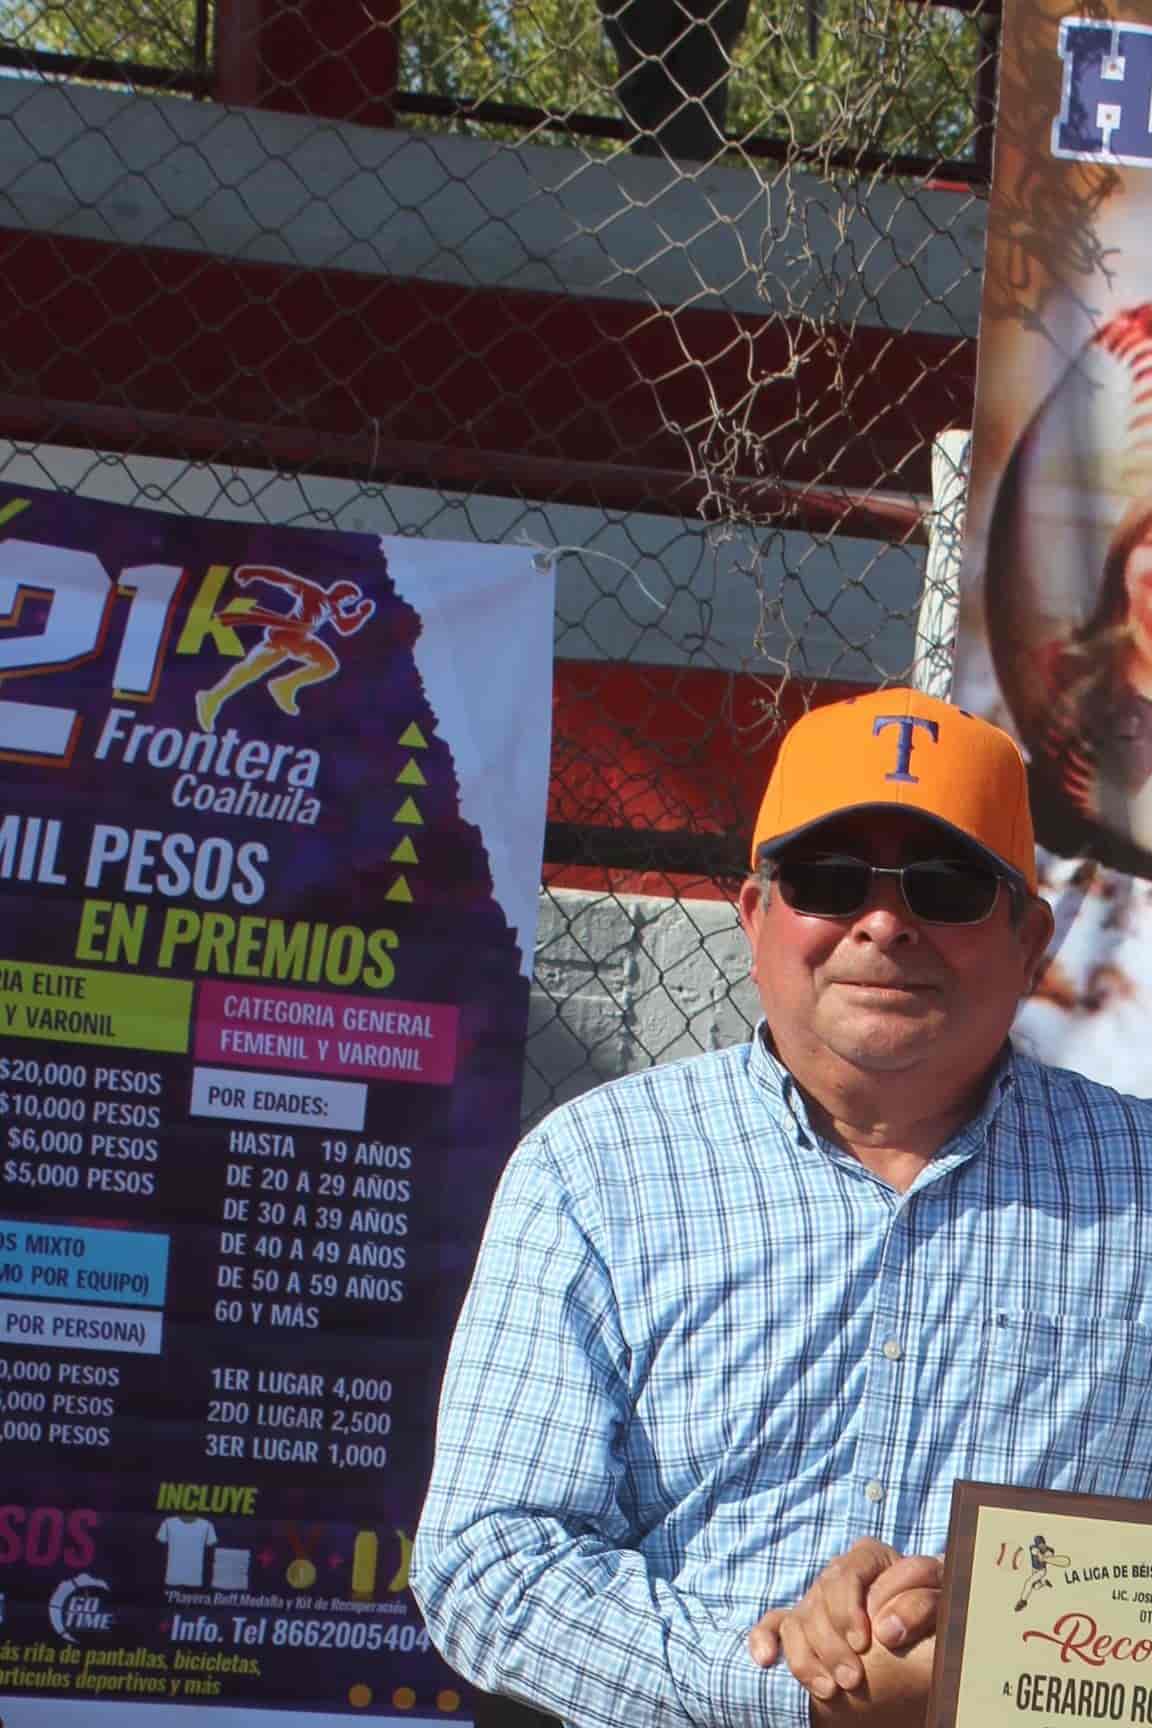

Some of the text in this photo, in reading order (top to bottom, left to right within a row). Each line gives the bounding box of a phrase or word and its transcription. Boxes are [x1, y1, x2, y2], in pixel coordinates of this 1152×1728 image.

[94, 708, 321, 788] Frontera
[872, 715, 939, 784] T
[172, 773, 321, 825] Coahuila
[84, 824, 269, 904] PESOS
[75, 899, 399, 988] EN PREMIOS
[33, 973, 86, 999] ELITE
[6, 1004, 116, 1037] Y VARONIL
[223, 995, 433, 1038] CATEGORIA GENERAL
[220, 1029, 423, 1072] FEMENIL Y VARONIL
[0, 1057, 162, 1095] $20,000 PESOS
[93, 1101, 161, 1128] PESOS
[208, 1086, 329, 1116] POR EDADES:
[8, 1126, 158, 1162] $6,000 PESOS
[229, 1131, 412, 1169] HASTA 19 AÑOS
[4, 1159, 155, 1195] $5,000 PESOS
[226, 1164, 411, 1202] DE 20 A 29 AÑOS
[223, 1198, 409, 1236] DE 30 A 39 AÑOS
[26, 1234, 85, 1257] MIXTO
[220, 1231, 406, 1269] DE 40 A 49 AÑOS
[31, 1265, 69, 1288] POR
[77, 1269, 149, 1296] EQUIPO)
[217, 1265, 403, 1302] DE 50 A 59 AÑOS
[6, 1313, 146, 1346] POR PERSONA)
[215, 1300, 243, 1322] 60
[252, 1303, 263, 1325] Y
[58, 1363, 120, 1387] PESOS
[212, 1368, 392, 1402] 1ER LUGAR 4,000
[52, 1393, 114, 1417] PESOS
[207, 1401, 391, 1435] 2DO LUGAR 2,500
[49, 1423, 111, 1447] PESOS
[205, 1434, 387, 1468] 3ER LUGAR 1,000
[156, 1482, 258, 1515] INCLUYE
[1064, 1569, 1081, 1585] LA
[1083, 1567, 1110, 1582] LIGA
[1113, 1565, 1129, 1579] DE
[65, 1612, 113, 1631] TIME
[69, 1596, 99, 1613] GO
[170, 1614, 223, 1643] Info.
[232, 1615, 268, 1645] Tel
[23, 1641, 56, 1663] rifa
[59, 1644, 81, 1665] de
[75, 1671, 166, 1694] deportivos
[170, 1678, 181, 1696] y
[1016, 1673, 1125, 1721] GERARDO
